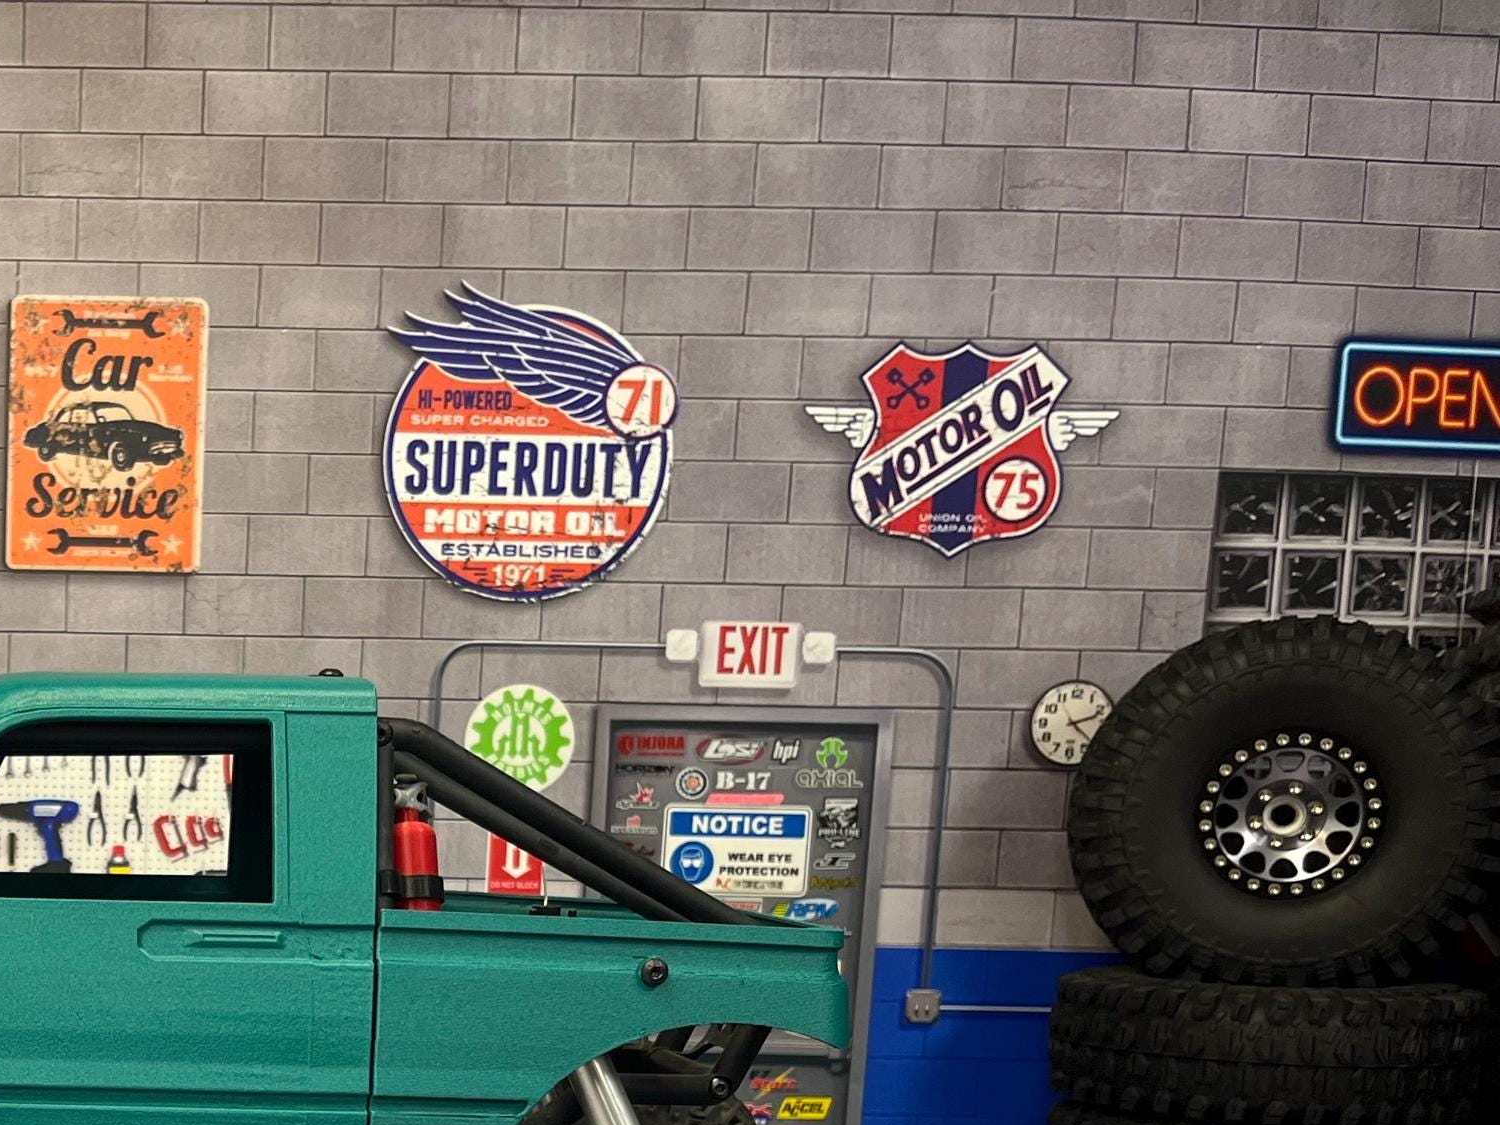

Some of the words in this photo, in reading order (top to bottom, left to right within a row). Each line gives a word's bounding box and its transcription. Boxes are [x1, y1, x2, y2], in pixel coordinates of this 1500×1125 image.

[61, 338, 153, 392] Car
[417, 389, 513, 411] HI-POWERED
[617, 380, 663, 425] 71
[1355, 366, 1500, 429] OPEN
[410, 413, 465, 427] SUPER
[470, 414, 549, 428] CHARGED
[860, 404, 988, 521] MOTOR
[991, 363, 1053, 431] OIL
[404, 439, 651, 499] SUPERDUTY
[26, 473, 180, 520] Service
[992, 473, 1040, 510] 75
[423, 508, 556, 536] MOTOR
[564, 511, 626, 537] OIL
[918, 523, 986, 534] COMPANY
[919, 513, 961, 523] UNION
[441, 542, 602, 560] ESTABLISHED
[491, 563, 547, 588] 1971
[716, 625, 790, 676] EXIT
[491, 700, 552, 725] HOLMES
[1044, 703, 1058, 715] 10
[771, 739, 801, 764] hpi
[1052, 742, 1061, 753] 7
[715, 771, 772, 790] B-17
[690, 815, 784, 836] NOTICE
[728, 852, 764, 863] WEAR
[767, 853, 793, 863] EYE
[719, 866, 799, 877] PROTECTION
